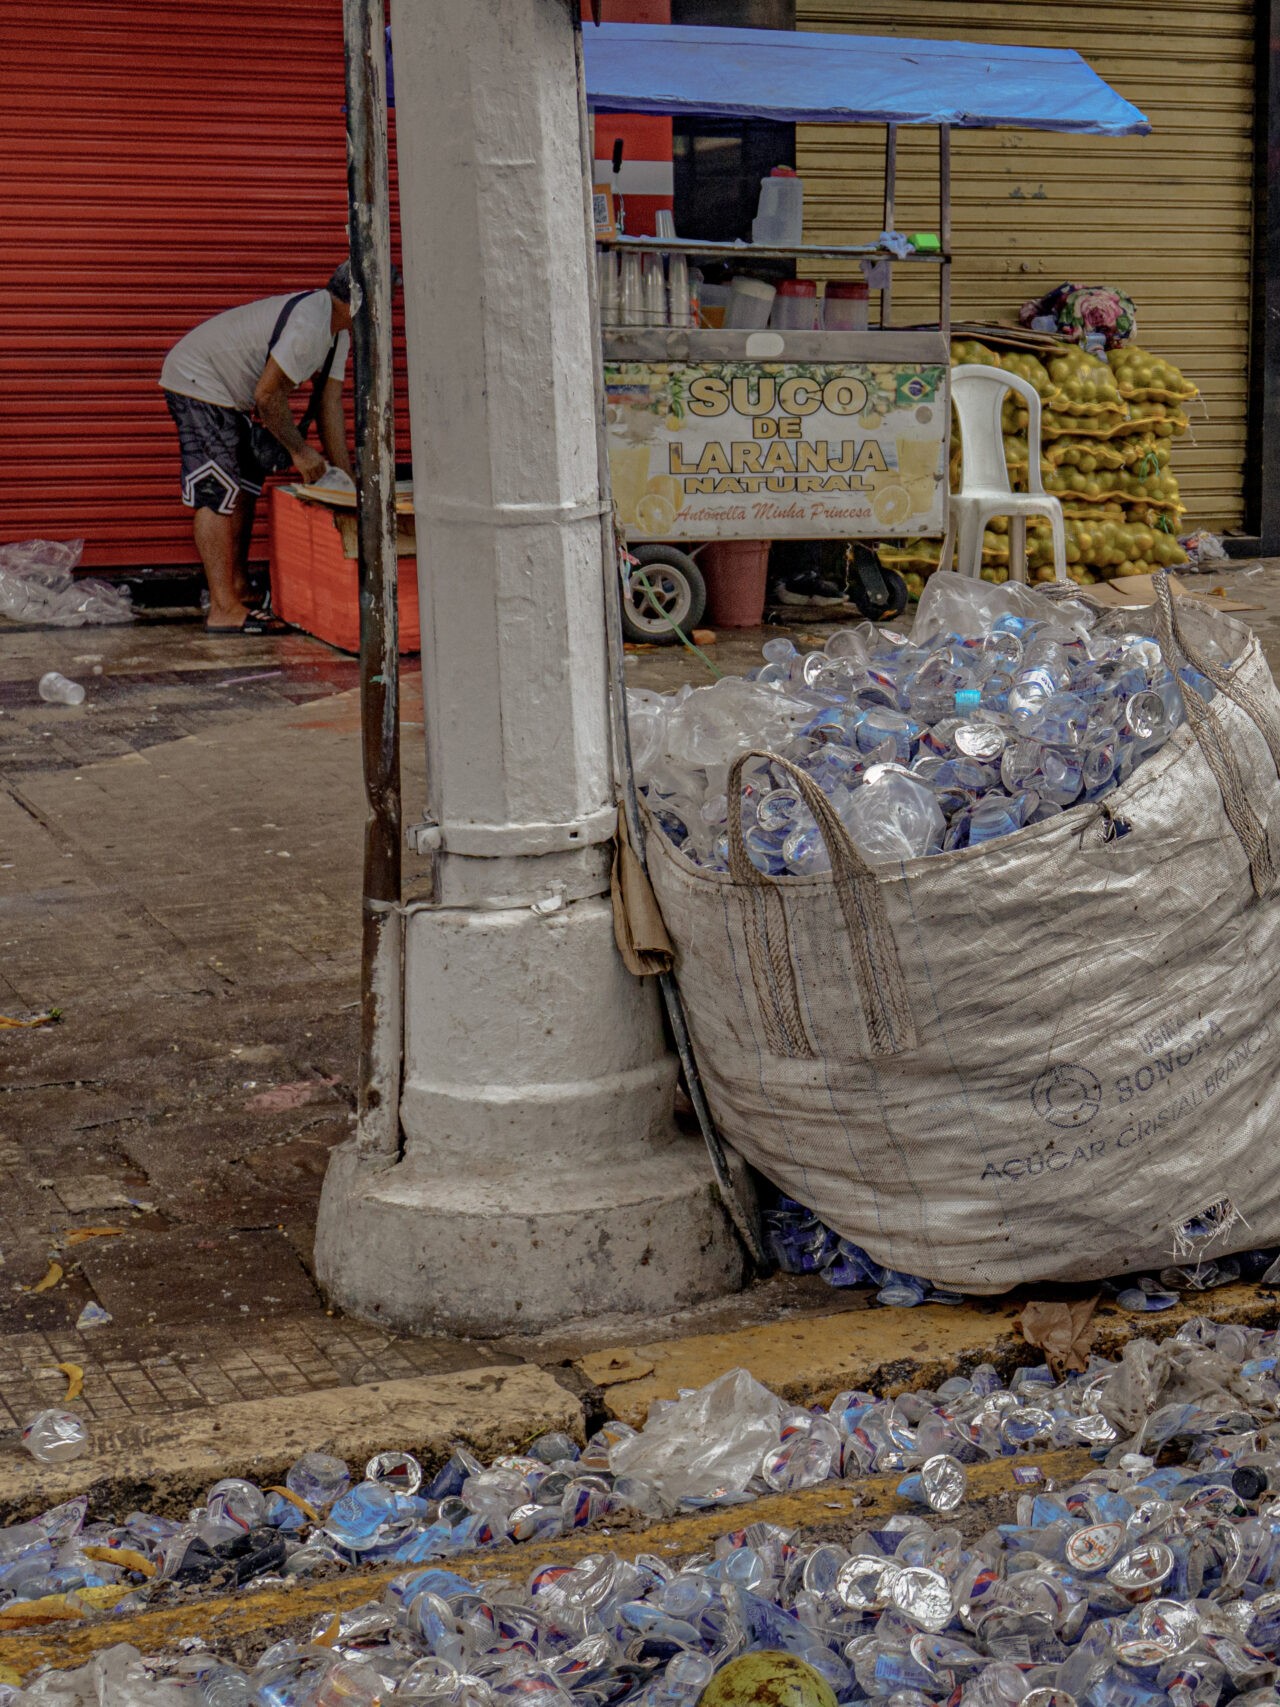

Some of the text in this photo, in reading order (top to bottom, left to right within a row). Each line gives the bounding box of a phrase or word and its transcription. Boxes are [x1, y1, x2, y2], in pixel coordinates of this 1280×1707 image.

[687, 375, 868, 417] SUCO
[752, 416, 803, 440] DE
[669, 440, 888, 475] LARANJA
[684, 475, 875, 494] NATURAL
[674, 502, 872, 523] Antonella Minha Princesa
[1138, 1017, 1186, 1056] USINA
[1115, 1019, 1225, 1104] SONORA
[1115, 1092, 1202, 1149] CRISTAL
[1204, 1026, 1272, 1098] BRANCO
